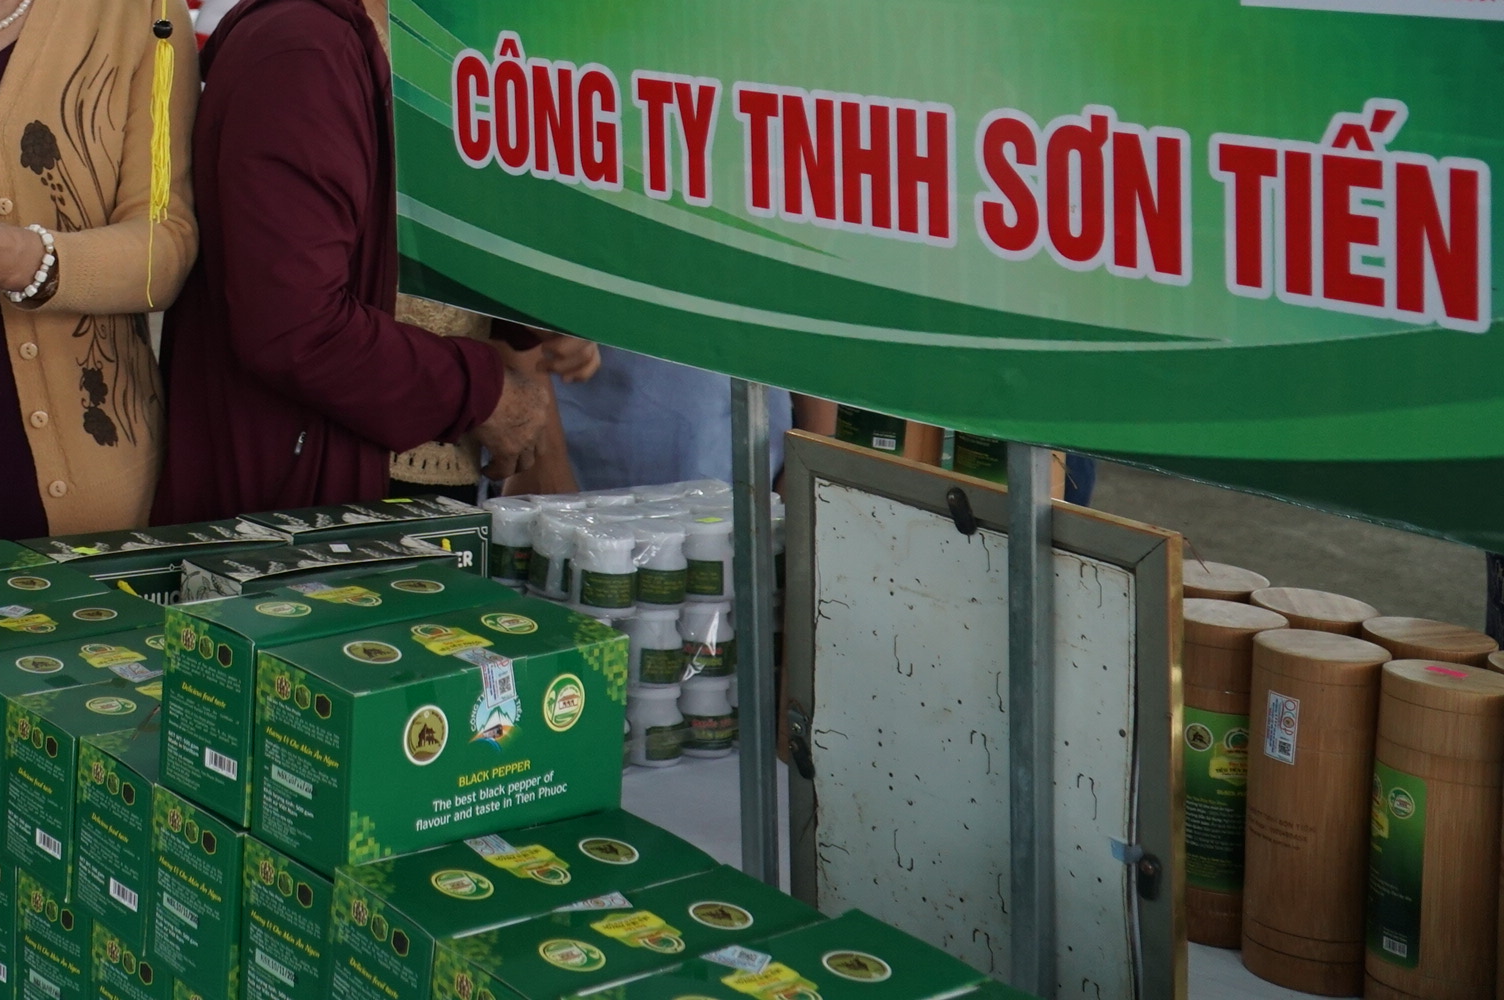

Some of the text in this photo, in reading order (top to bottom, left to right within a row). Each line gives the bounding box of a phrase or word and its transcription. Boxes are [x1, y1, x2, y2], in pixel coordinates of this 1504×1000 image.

[455, 37, 1480, 323] CÔNG TY TNHH SƠN TIẾN
[432, 771, 555, 812] The best black pepper of
[458, 760, 531, 788] BLACK PEPPER
[416, 783, 568, 832] flavour and taste in Tien Phuoc
